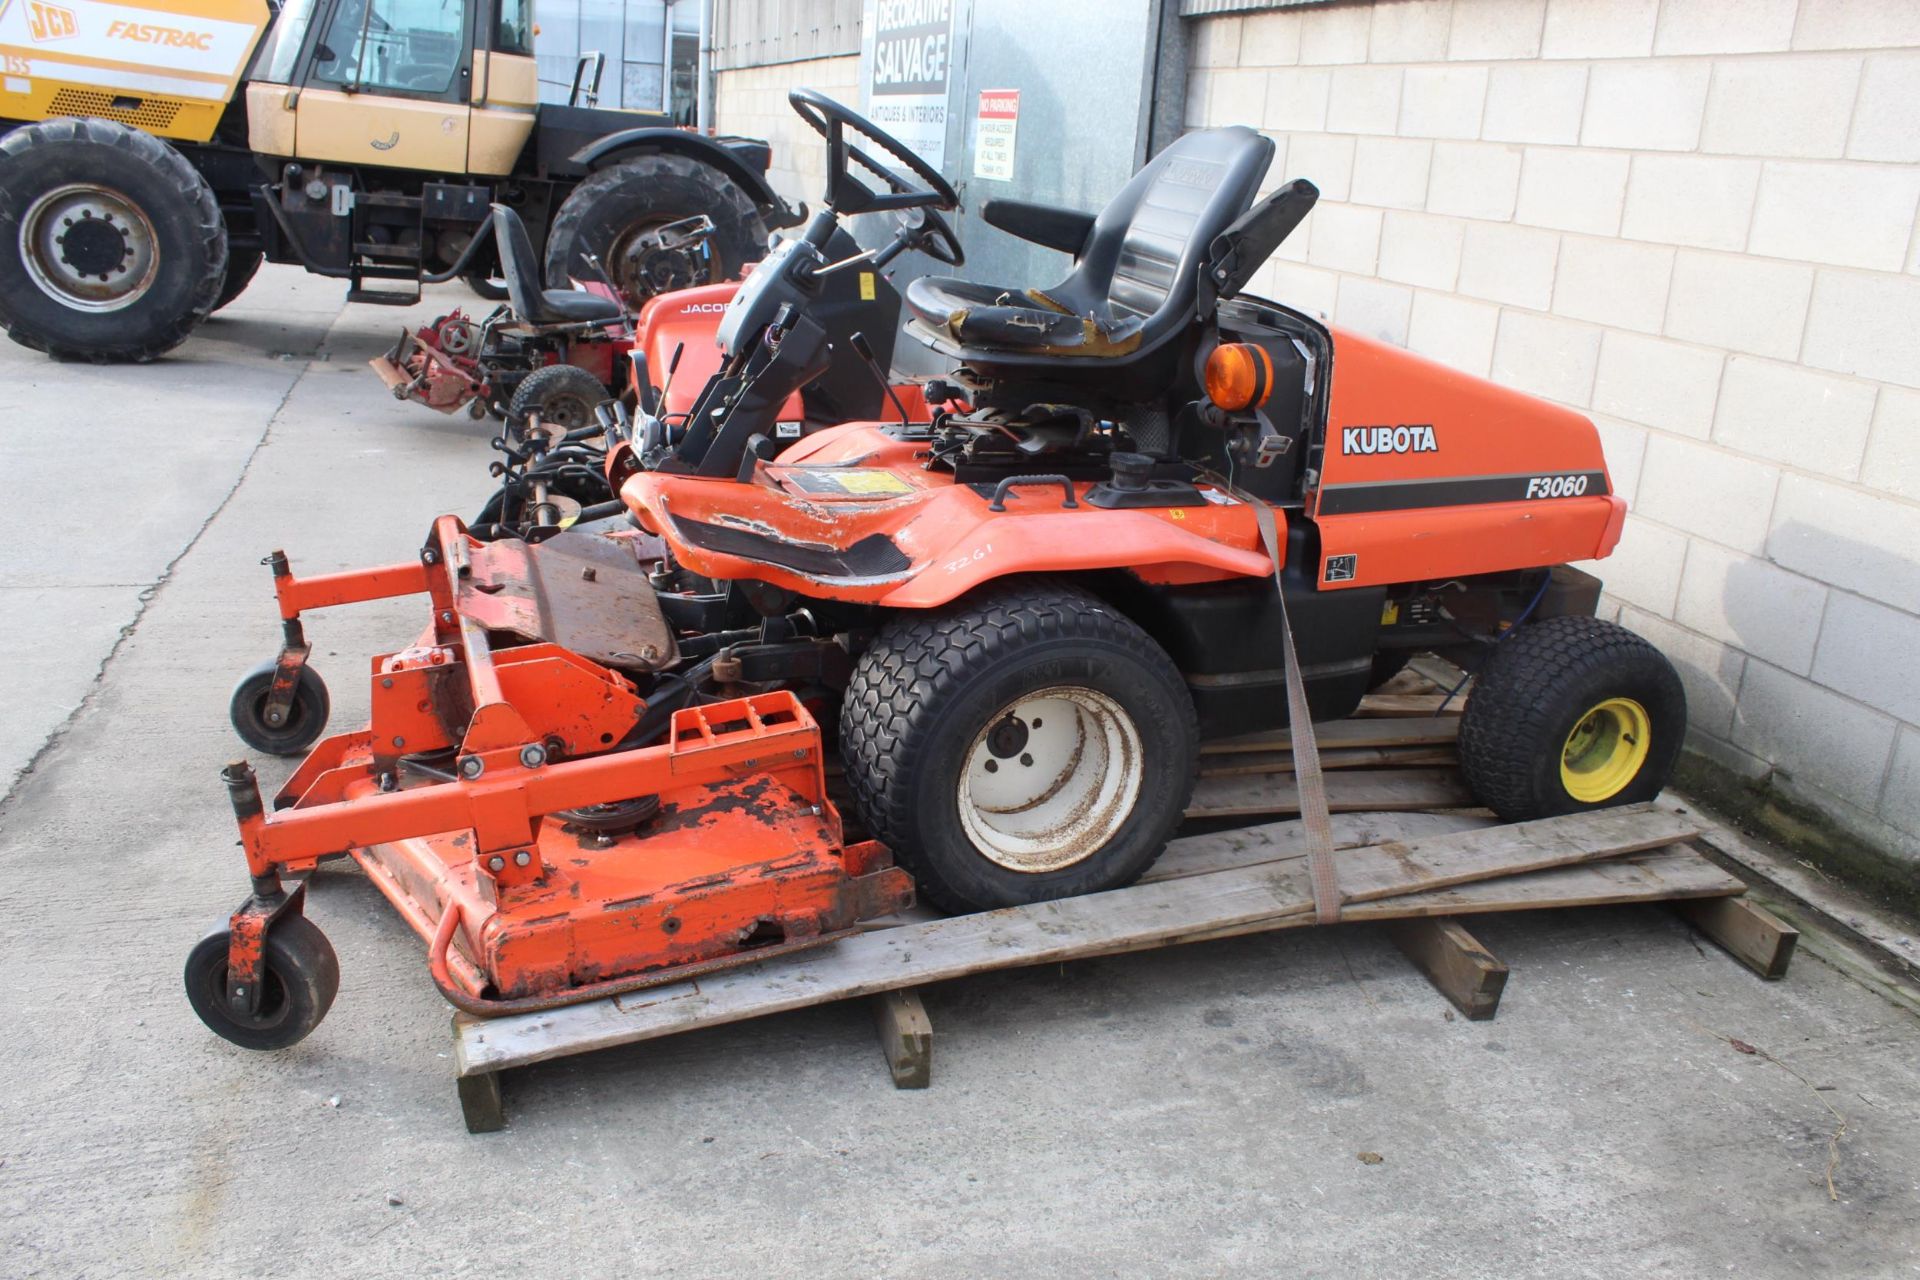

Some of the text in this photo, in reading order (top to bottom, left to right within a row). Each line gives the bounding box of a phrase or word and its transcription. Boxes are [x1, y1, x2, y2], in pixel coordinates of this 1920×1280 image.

[31, 2, 76, 39] JCB
[878, 0, 949, 32] DECORATIVE
[106, 20, 214, 51] FASTRAC
[875, 33, 947, 84] SALVAGE
[870, 104, 900, 122] ANTIQUES
[908, 104, 944, 124] INTERIORS
[980, 97, 1017, 113] NO PARKING
[1343, 425, 1438, 455] KUBOTA
[1526, 475, 1588, 499] F3060
